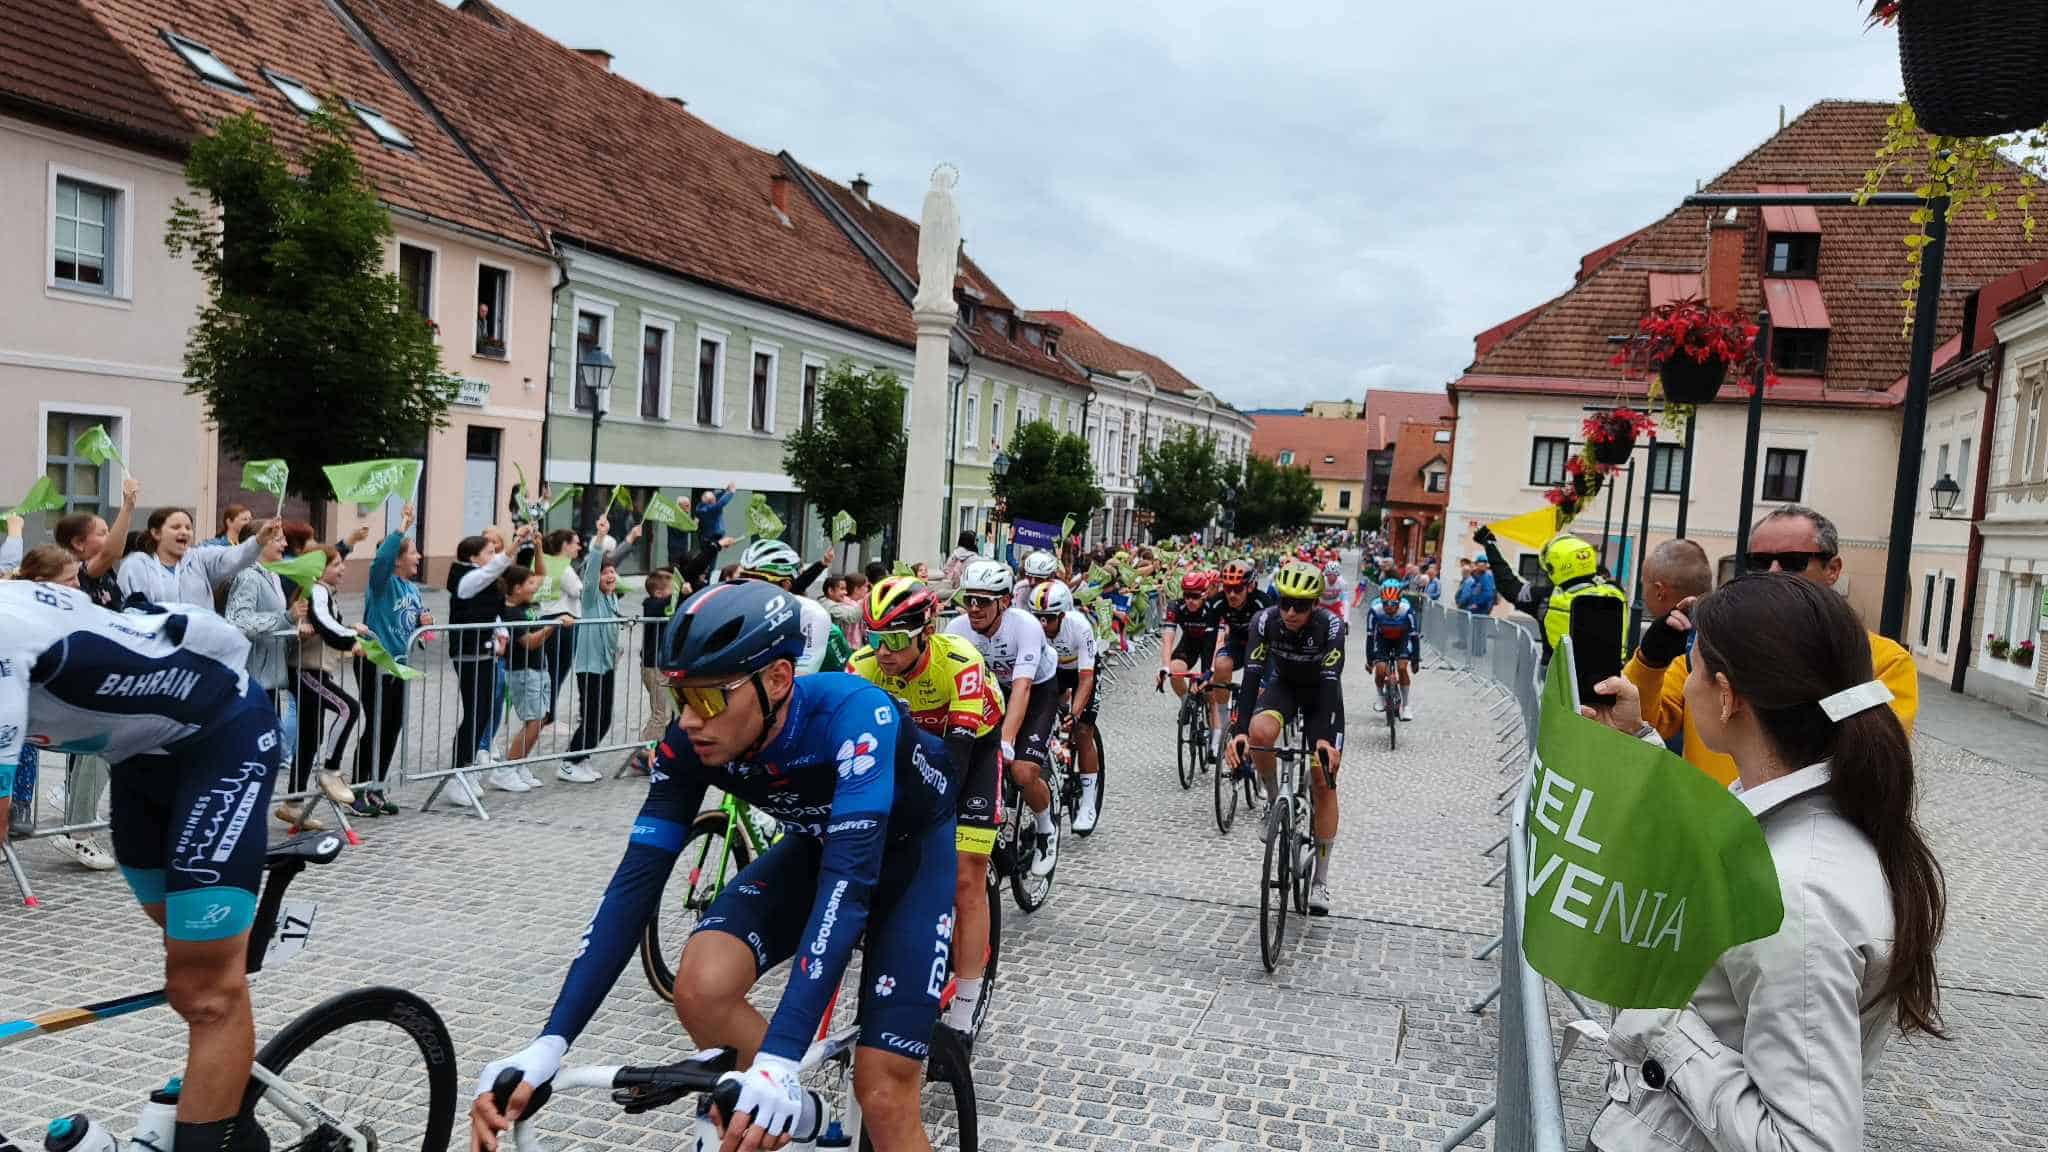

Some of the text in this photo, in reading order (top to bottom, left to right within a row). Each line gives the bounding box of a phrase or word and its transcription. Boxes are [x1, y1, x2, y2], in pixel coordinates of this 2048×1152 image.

[96, 667, 201, 701] BAHRAIN
[911, 742, 949, 796] Groupama
[172, 761, 267, 884] friendly
[176, 795, 212, 853] BUSINESS
[1533, 758, 1602, 855] EL
[810, 879, 849, 955] Groupama
[1528, 832, 1687, 952] VENIA
[281, 915, 310, 943] 17
[926, 940, 949, 999] FDJ
